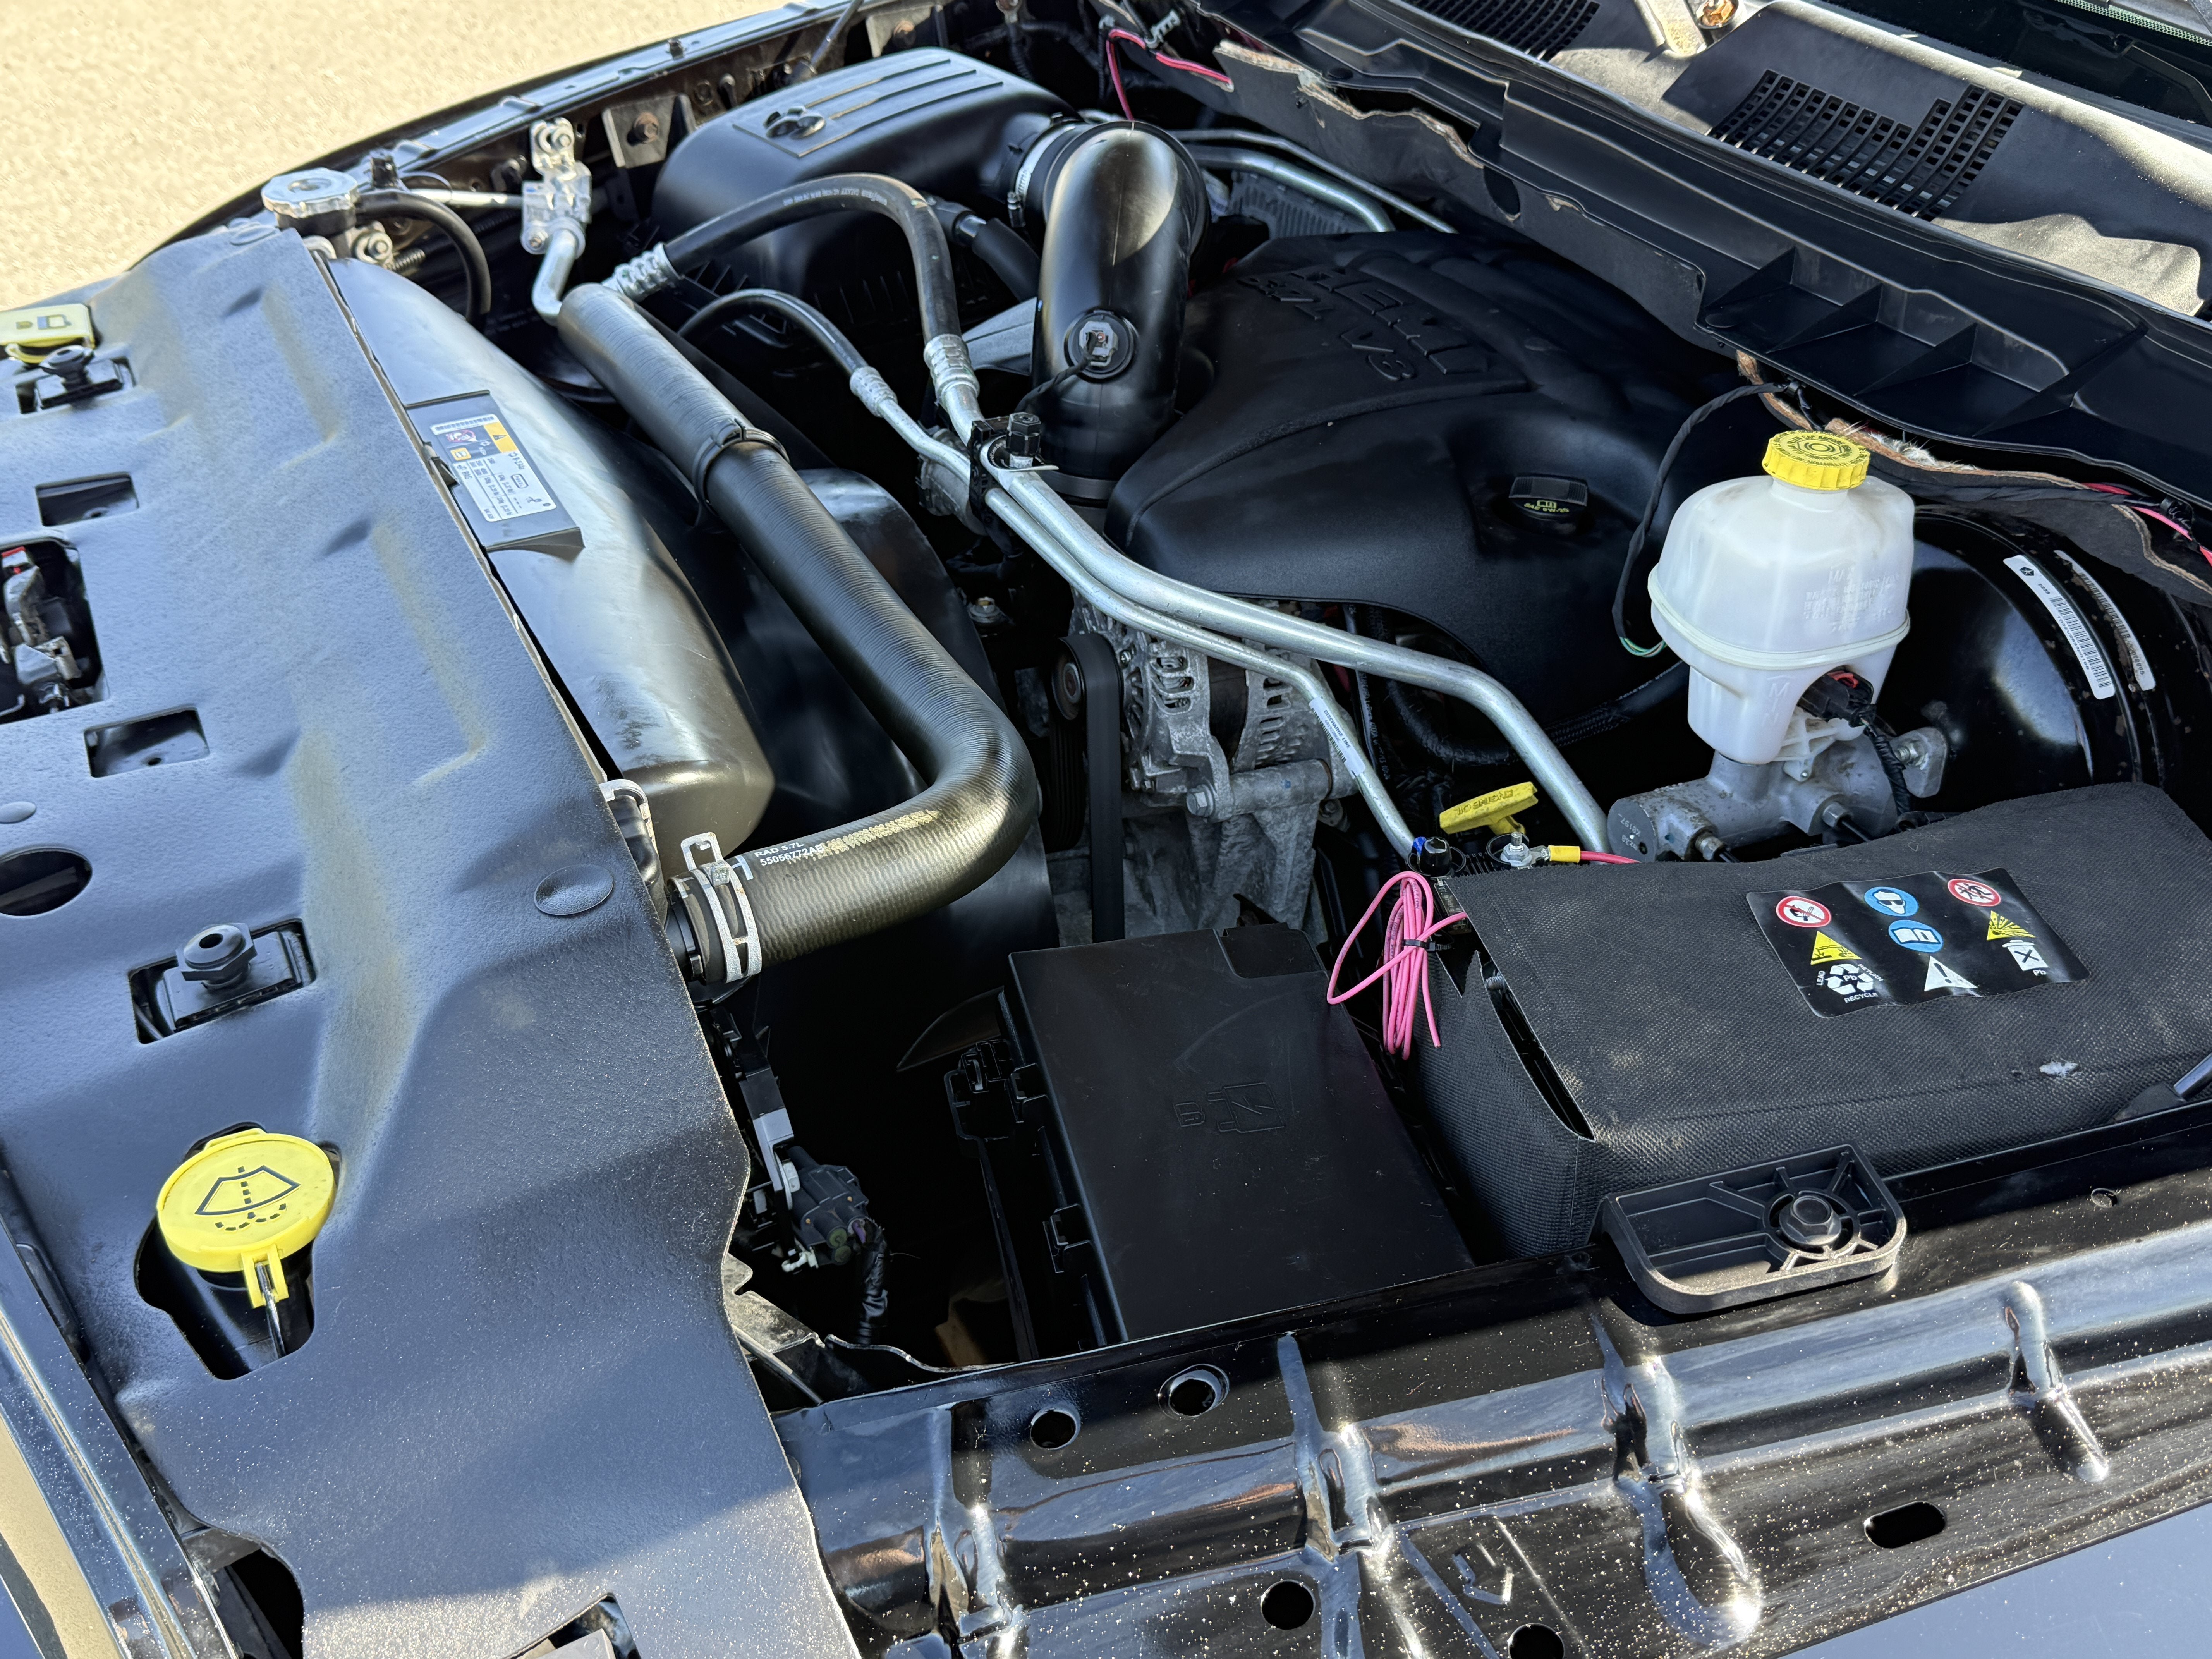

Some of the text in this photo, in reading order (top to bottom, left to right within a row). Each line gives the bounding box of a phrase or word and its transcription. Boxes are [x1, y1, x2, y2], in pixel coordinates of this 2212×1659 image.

[1324, 709, 1351, 748] DISCHARGE LINE
[1453, 788, 1514, 816] ENGINE OIL
[754, 842, 805, 857] RAD 5.7L
[759, 844, 825, 866] 55056772AB
[1816, 963, 1884, 1003] LEAD RETURN RECYCLE
[2032, 969, 2047, 977] Pb
